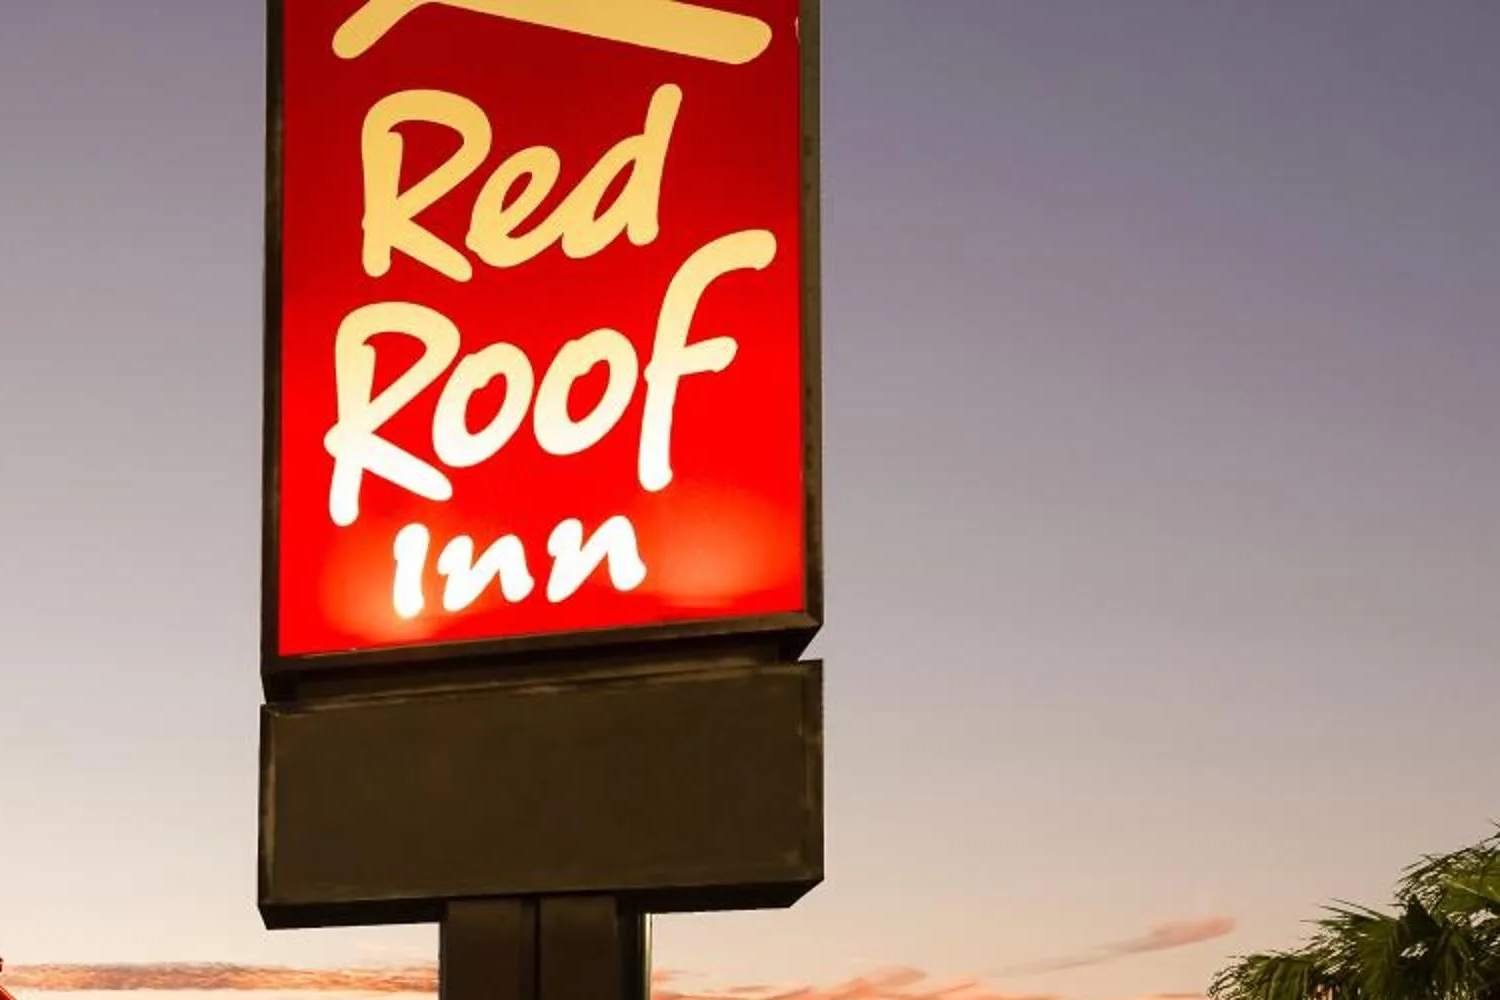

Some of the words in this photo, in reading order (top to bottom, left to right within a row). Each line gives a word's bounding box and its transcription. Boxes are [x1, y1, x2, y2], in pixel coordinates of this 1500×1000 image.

[362, 84, 683, 283] Red
[324, 230, 777, 527] Roof
[393, 515, 647, 619] Inn
